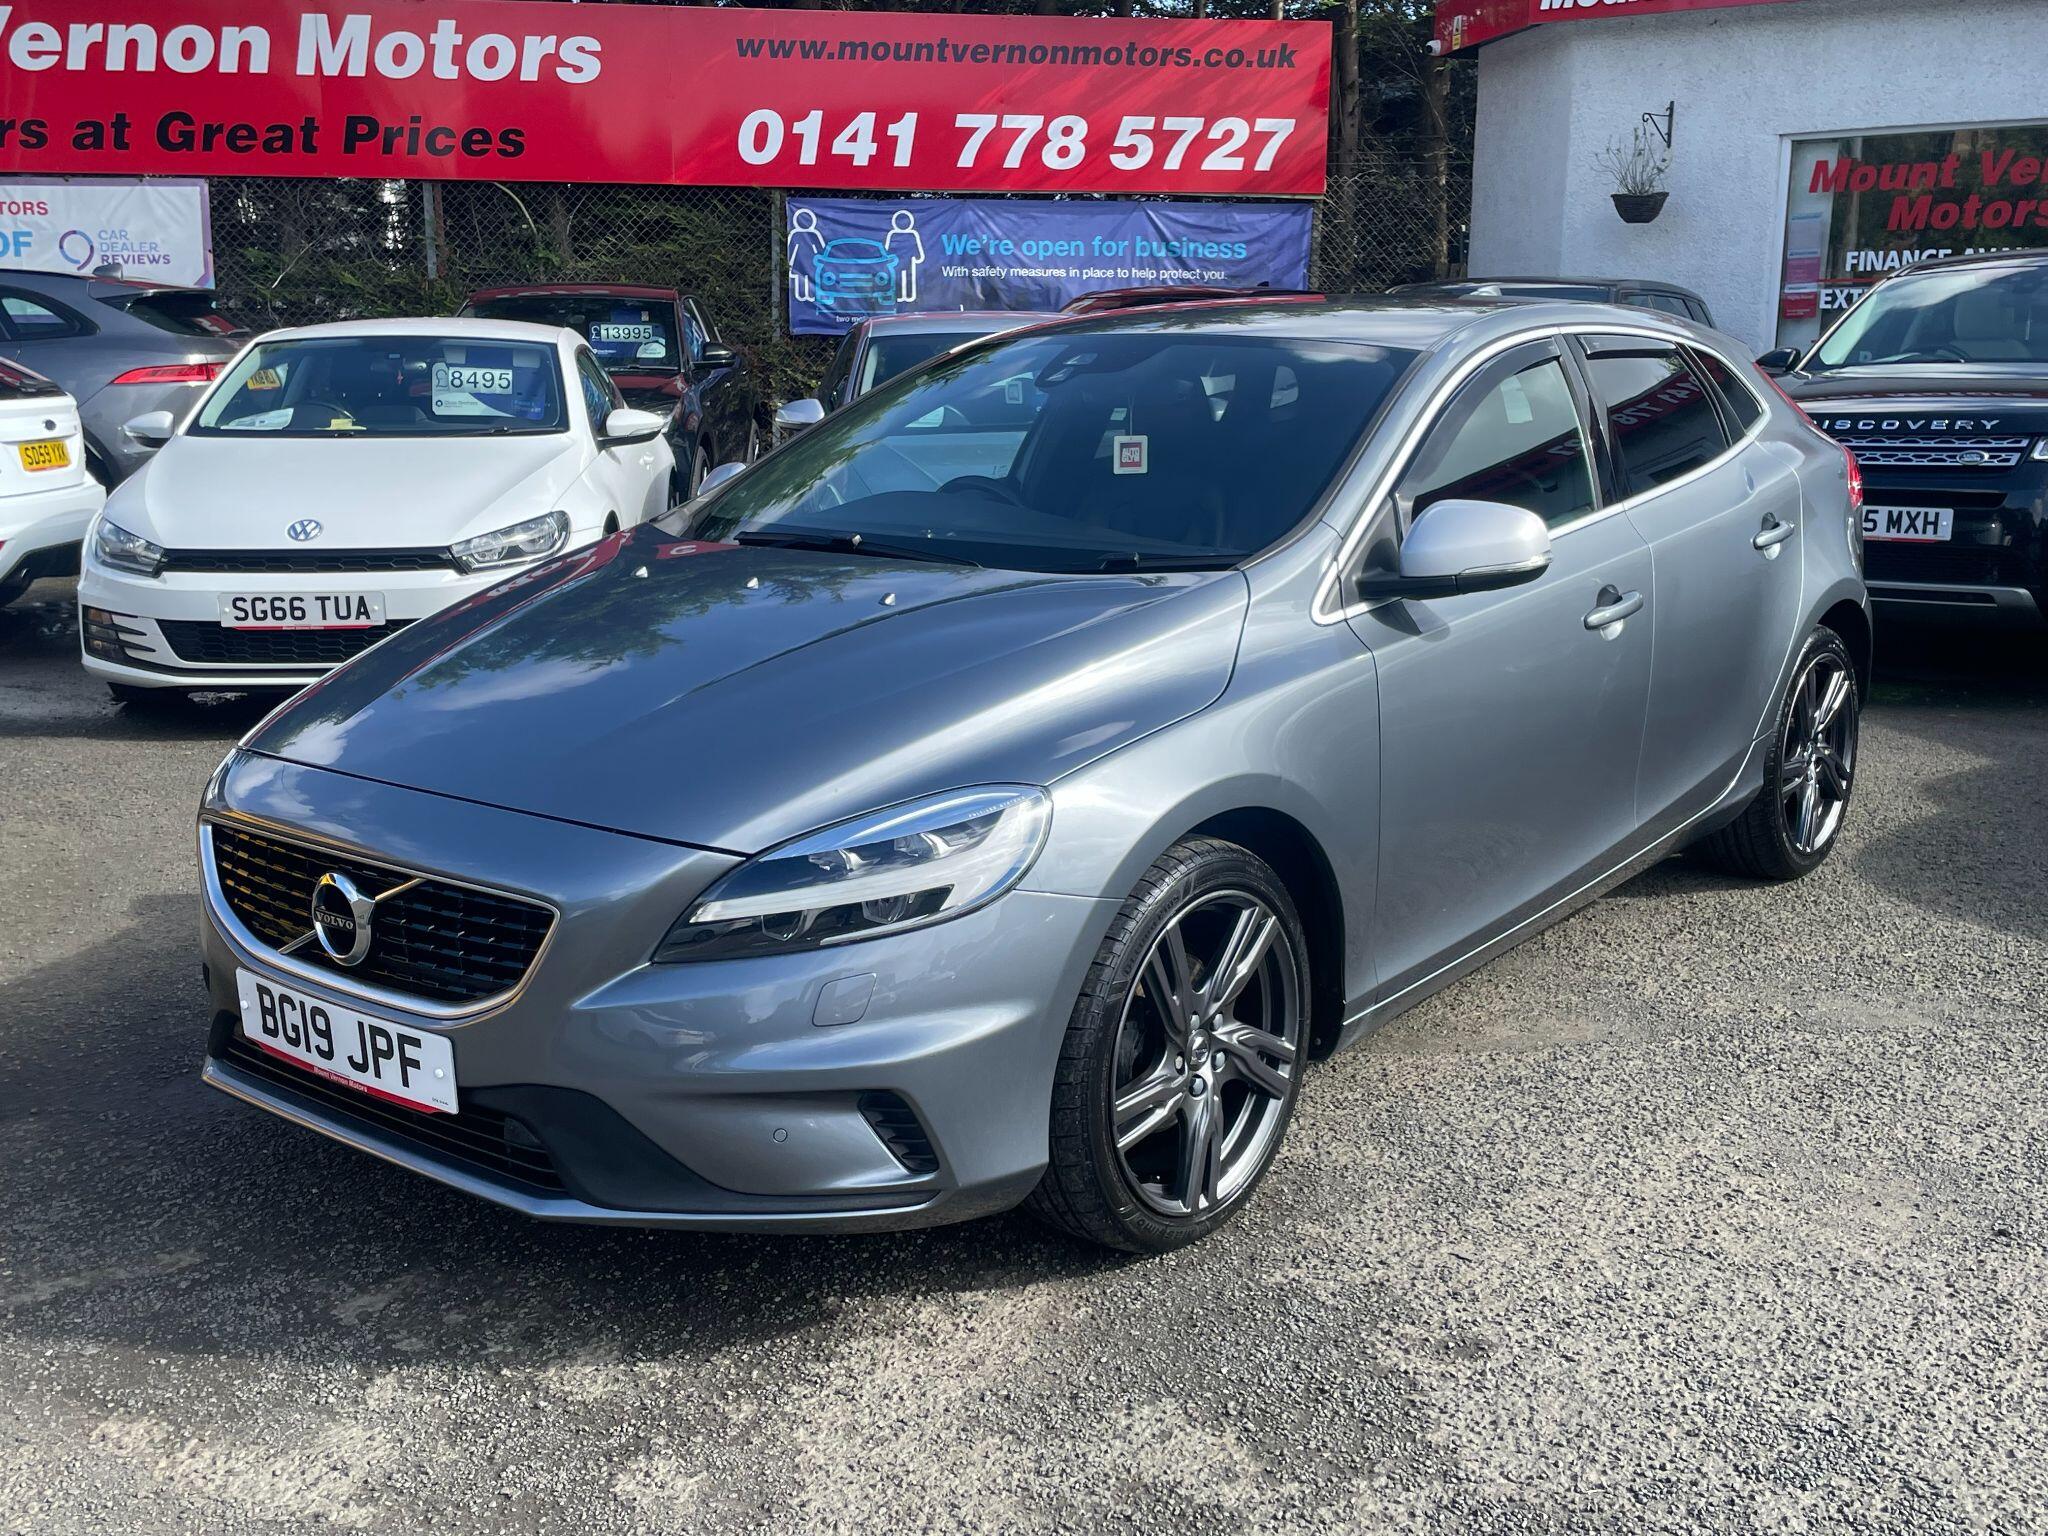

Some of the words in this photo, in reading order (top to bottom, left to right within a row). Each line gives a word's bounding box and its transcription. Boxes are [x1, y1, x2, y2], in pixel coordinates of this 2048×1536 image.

[0, 5, 270, 73] ernon
[296, 14, 601, 84] Motors
[736, 37, 1296, 68] www.mountvernonmotors.co.uk
[72, 113, 131, 150] at
[156, 111, 319, 154] Great
[343, 115, 525, 158] Prices
[738, 109, 920, 167] 0141
[955, 113, 1086, 169] 778
[1109, 115, 1295, 171] 5727
[1808, 153, 1960, 193] Mount
[98, 229, 129, 241] CAR
[100, 241, 158, 253] DEALER
[1021, 238, 1084, 260] open
[1091, 235, 1129, 257] for
[1135, 236, 1247, 259] business
[101, 254, 170, 265] REVIEWS
[942, 265, 969, 278] With
[971, 265, 1007, 281] safety
[1010, 267, 1066, 278] measures
[1069, 266, 1080, 278] in
[1083, 267, 1114, 280] place
[1117, 268, 1129, 278] to
[1132, 267, 1157, 281] help
[1159, 268, 1201, 281] protect
[1203, 271, 1228, 281] you.
[1813, 419, 2000, 430] ISCOVERY
[24, 445, 52, 465] SD59
[1886, 510, 1940, 535] MXH
[232, 597, 306, 621] SG66
[315, 596, 371, 620] TUA
[315, 910, 354, 930] VOLVO
[256, 983, 335, 1061] BG19
[347, 1021, 422, 1088] JPF
[349, 1080, 368, 1093] Motors
